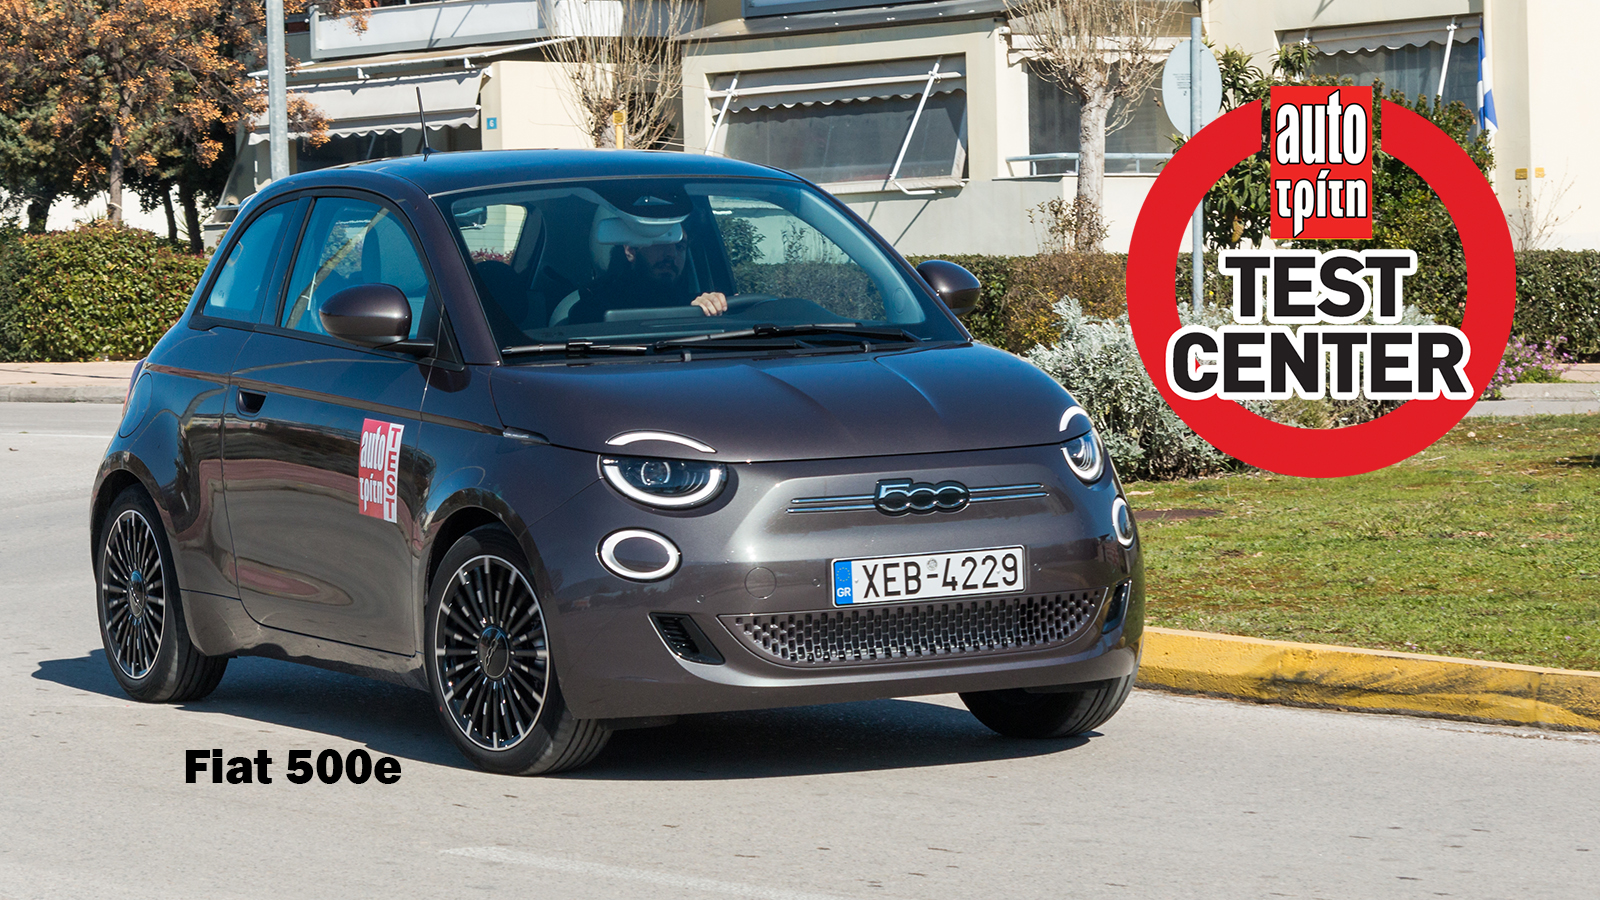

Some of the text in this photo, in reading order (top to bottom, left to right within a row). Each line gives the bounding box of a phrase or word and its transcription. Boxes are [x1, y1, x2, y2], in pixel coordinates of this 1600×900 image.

[360, 425, 386, 471] auto
[385, 427, 402, 519] TEST
[875, 479, 970, 515] 500
[836, 586, 852, 598] GR
[862, 553, 1018, 599] XEB-4229
